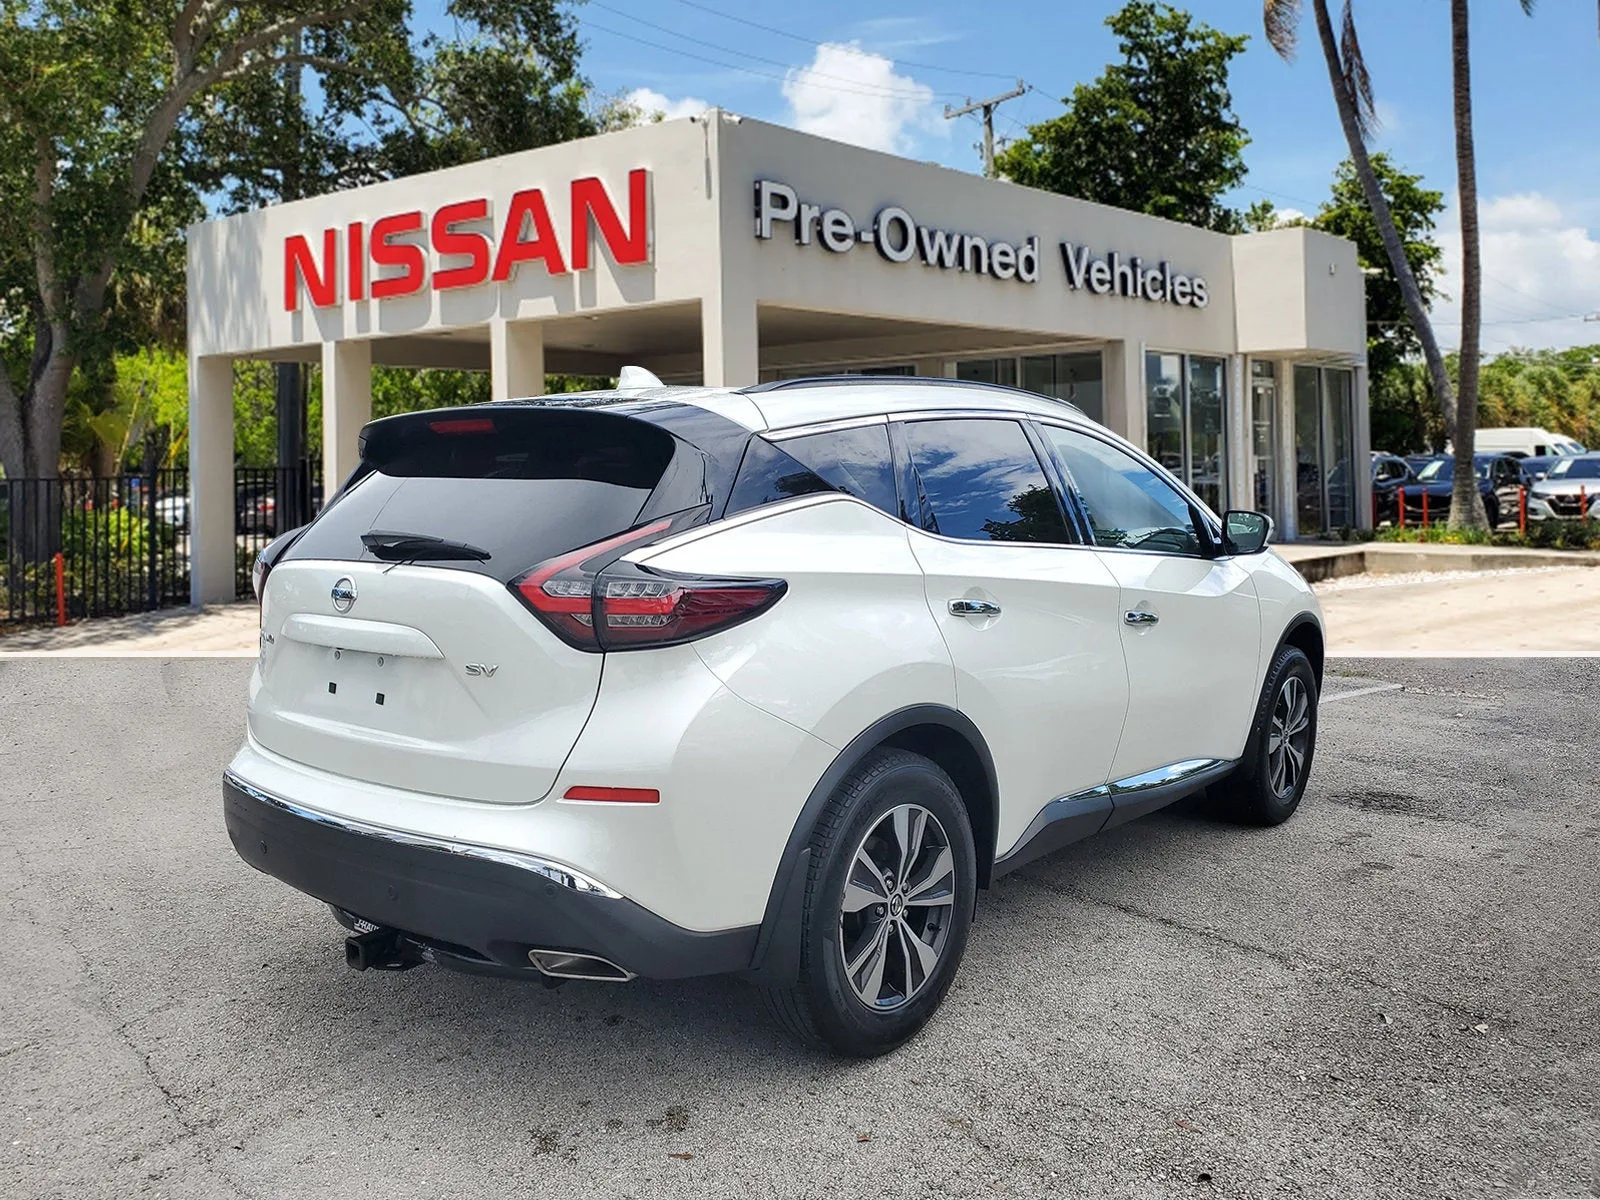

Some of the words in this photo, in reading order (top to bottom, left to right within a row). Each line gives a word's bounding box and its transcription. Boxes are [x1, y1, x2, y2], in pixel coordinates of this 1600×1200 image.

[284, 168, 648, 312] NISSAN
[754, 179, 1040, 284] Pre-Owned
[1060, 241, 1209, 308] Vehicles
[465, 663, 499, 677] SV
